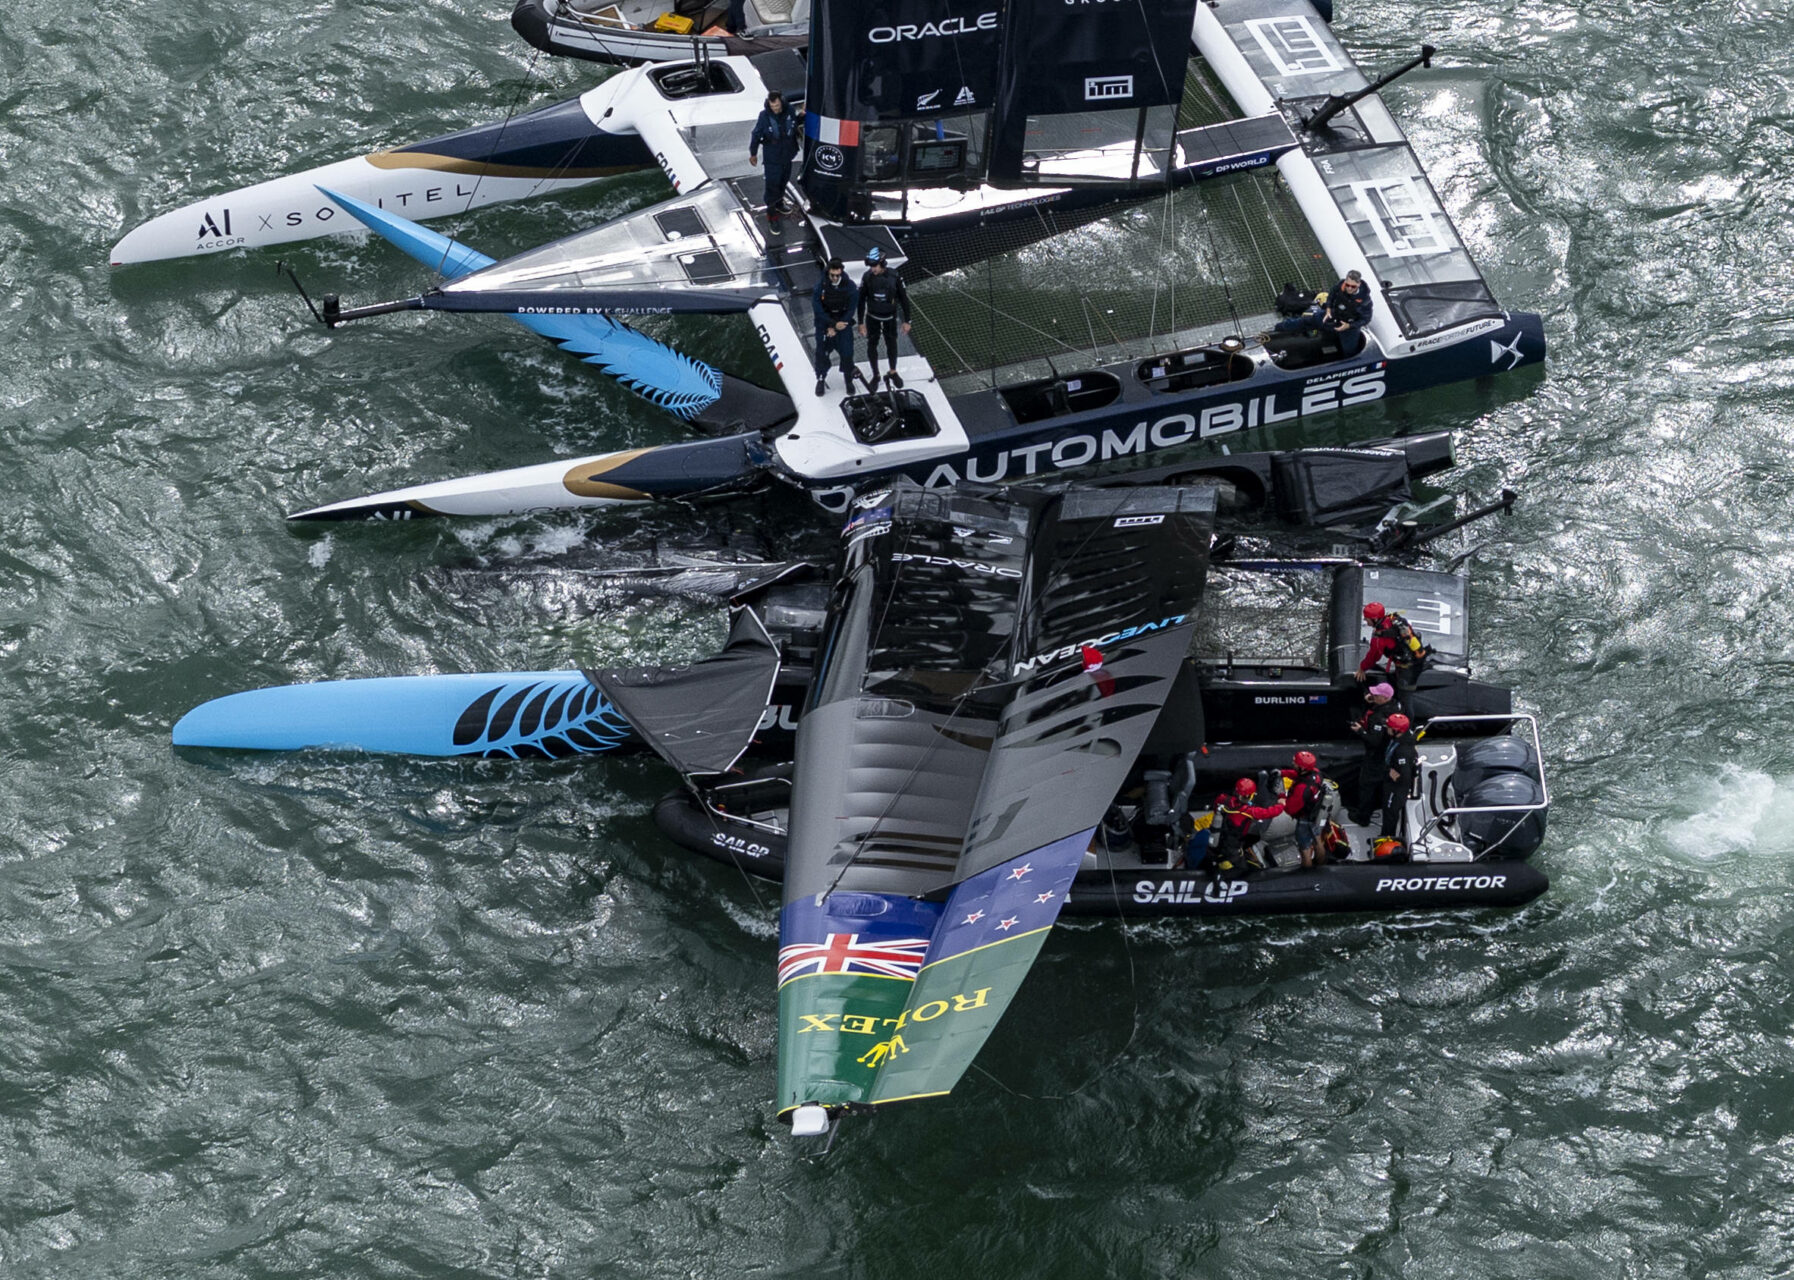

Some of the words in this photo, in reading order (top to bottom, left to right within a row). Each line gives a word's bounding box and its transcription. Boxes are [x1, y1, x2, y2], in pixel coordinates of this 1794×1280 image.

[868, 12, 998, 44] ORACLE
[1216, 165, 1230, 173] DP
[1231, 157, 1267, 169] WORLD
[286, 183, 473, 227] SOITEL
[196, 236, 245, 250] ACCOR
[518, 306, 581, 315] POWERED
[586, 307, 602, 315] BY
[1306, 367, 1367, 384] DELAPIERRE
[923, 370, 1387, 489] AUTOMOBILES
[891, 553, 1023, 578] ORACLE
[1254, 696, 1306, 705] BURLING
[1132, 880, 1249, 904] SAILGP
[1376, 876, 1507, 892] PROTECTOR
[797, 987, 992, 1035] ROLEX
